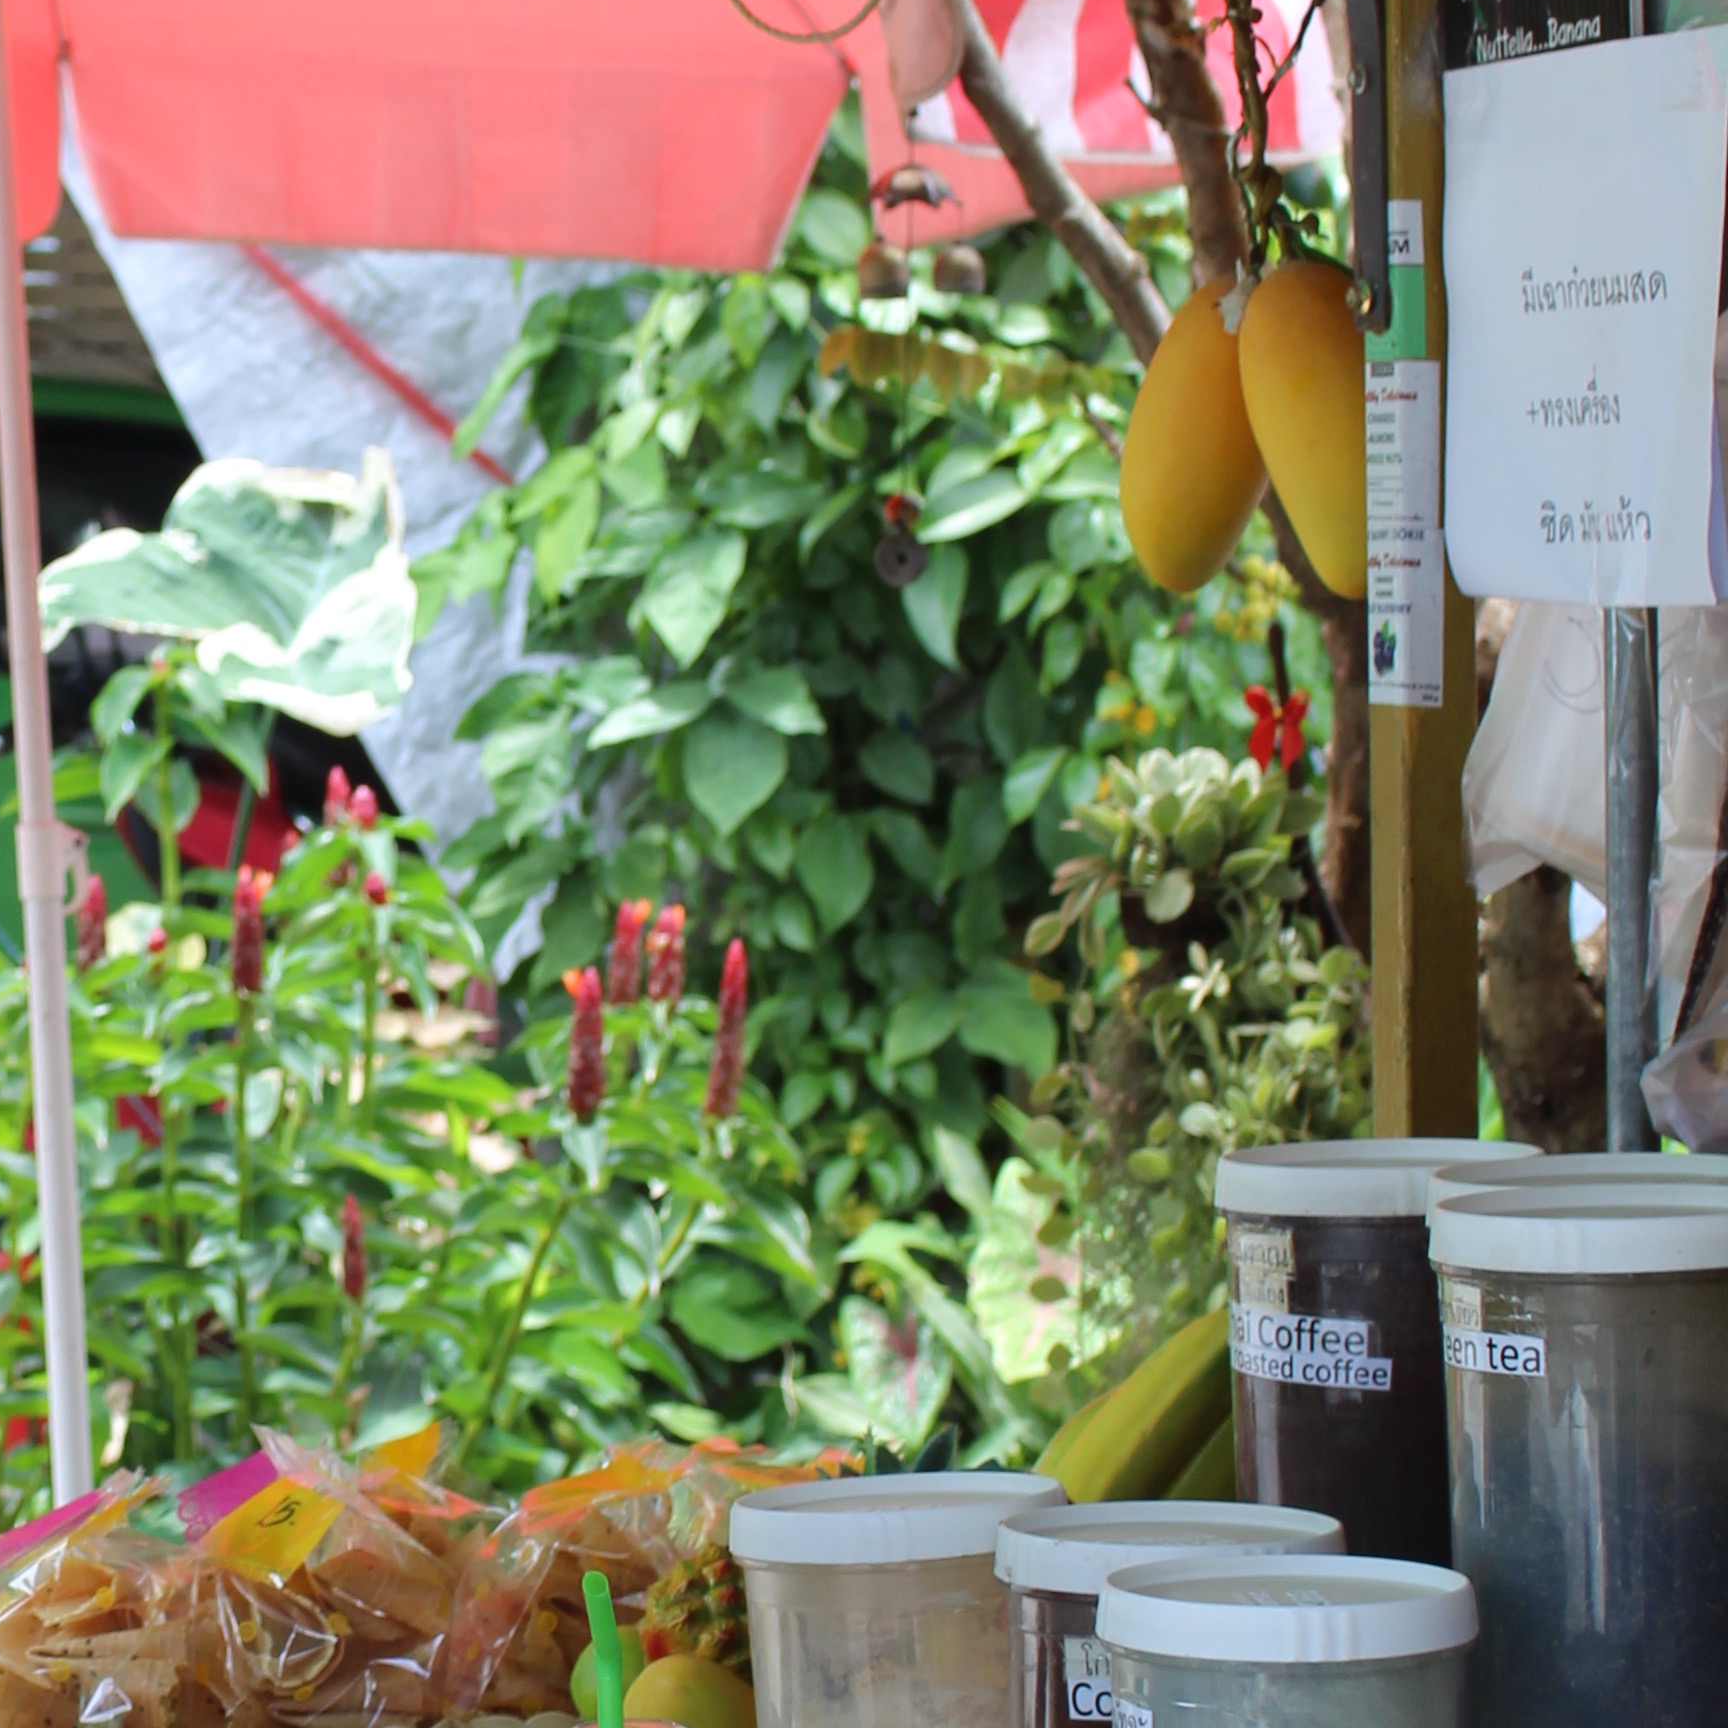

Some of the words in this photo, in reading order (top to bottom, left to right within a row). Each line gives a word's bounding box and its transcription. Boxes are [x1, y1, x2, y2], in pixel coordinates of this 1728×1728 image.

[1257, 1313, 1366, 1357] Coffee
[1302, 1356, 1390, 1388] coffee
[1444, 1336, 1477, 1368] een
[1485, 1335, 1542, 1374] tea
[1080, 1641, 1110, 1676] โก
